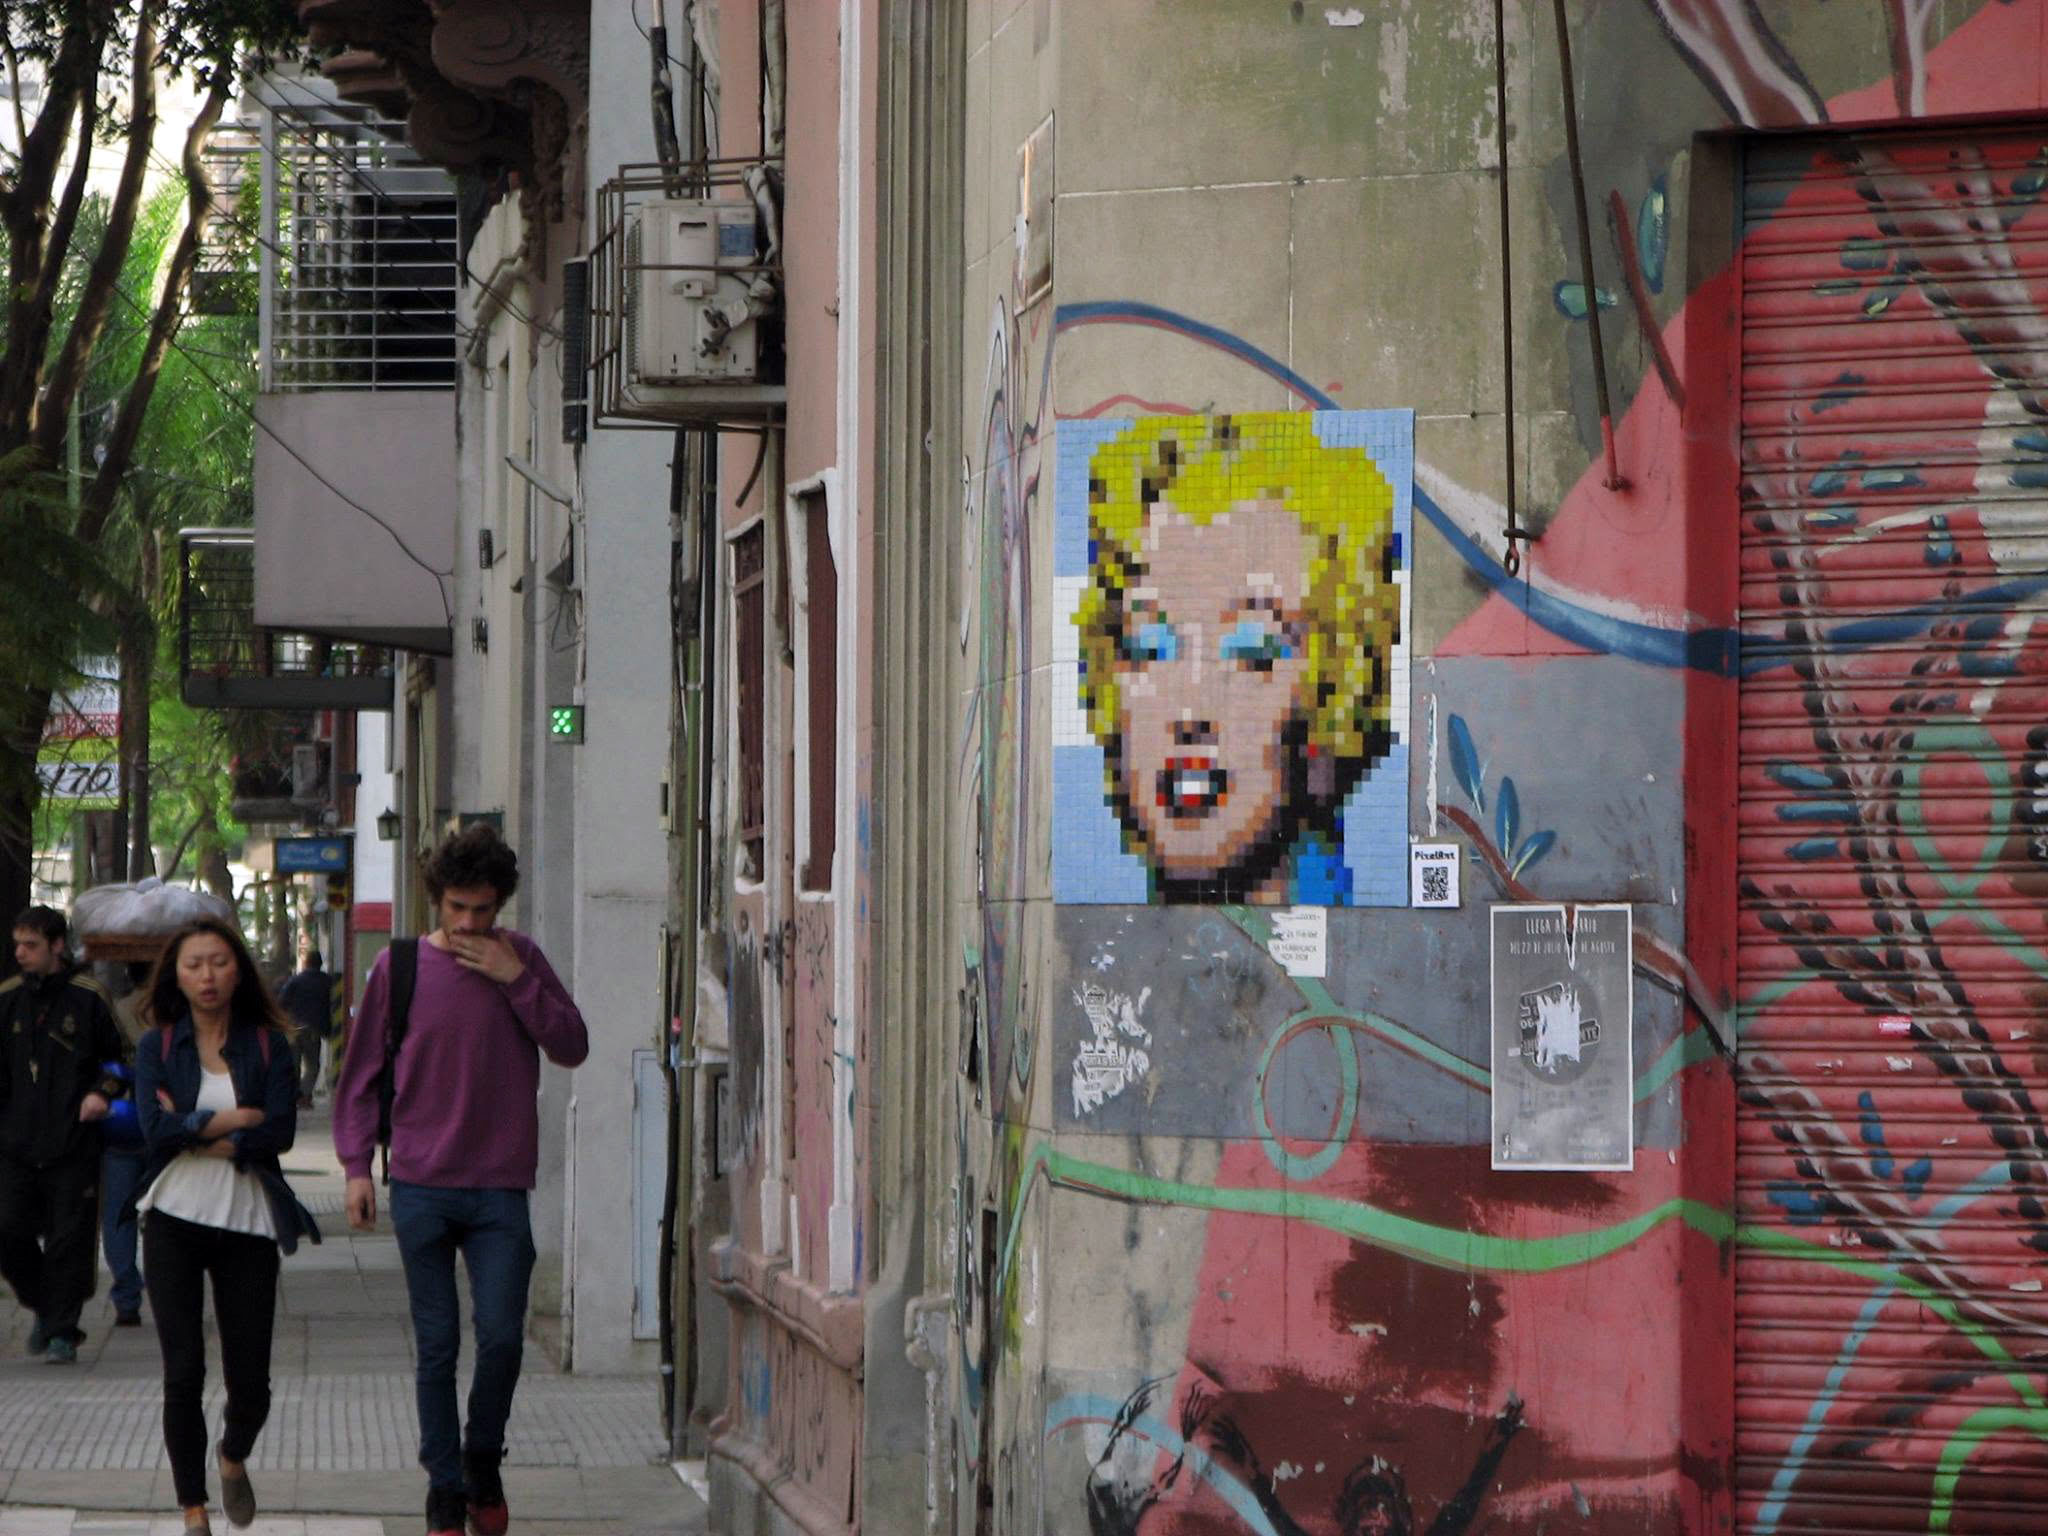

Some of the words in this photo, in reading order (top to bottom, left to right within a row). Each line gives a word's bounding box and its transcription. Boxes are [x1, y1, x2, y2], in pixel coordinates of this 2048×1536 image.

[1414, 850, 1456, 860] PixelArt
[1526, 918, 1552, 934] LLEGA
[1590, 942, 1616, 953] AGOSTO
